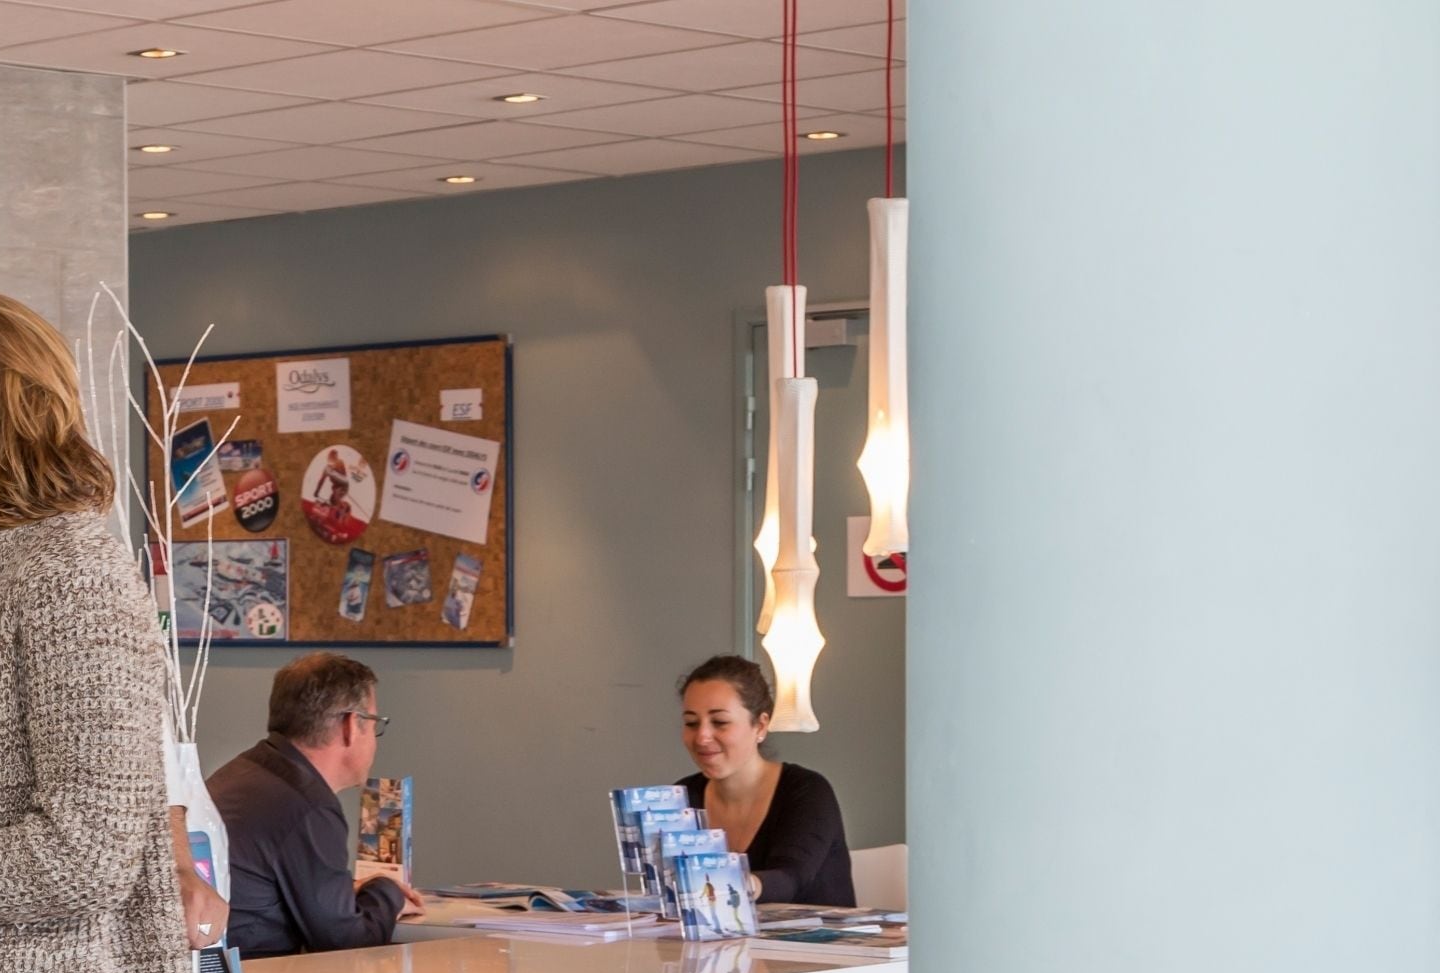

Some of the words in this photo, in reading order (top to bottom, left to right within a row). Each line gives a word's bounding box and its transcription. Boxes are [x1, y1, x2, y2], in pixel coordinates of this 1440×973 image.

[453, 403, 472, 416] ESF
[235, 481, 274, 507] SPORT
[241, 498, 274, 518] 2000
